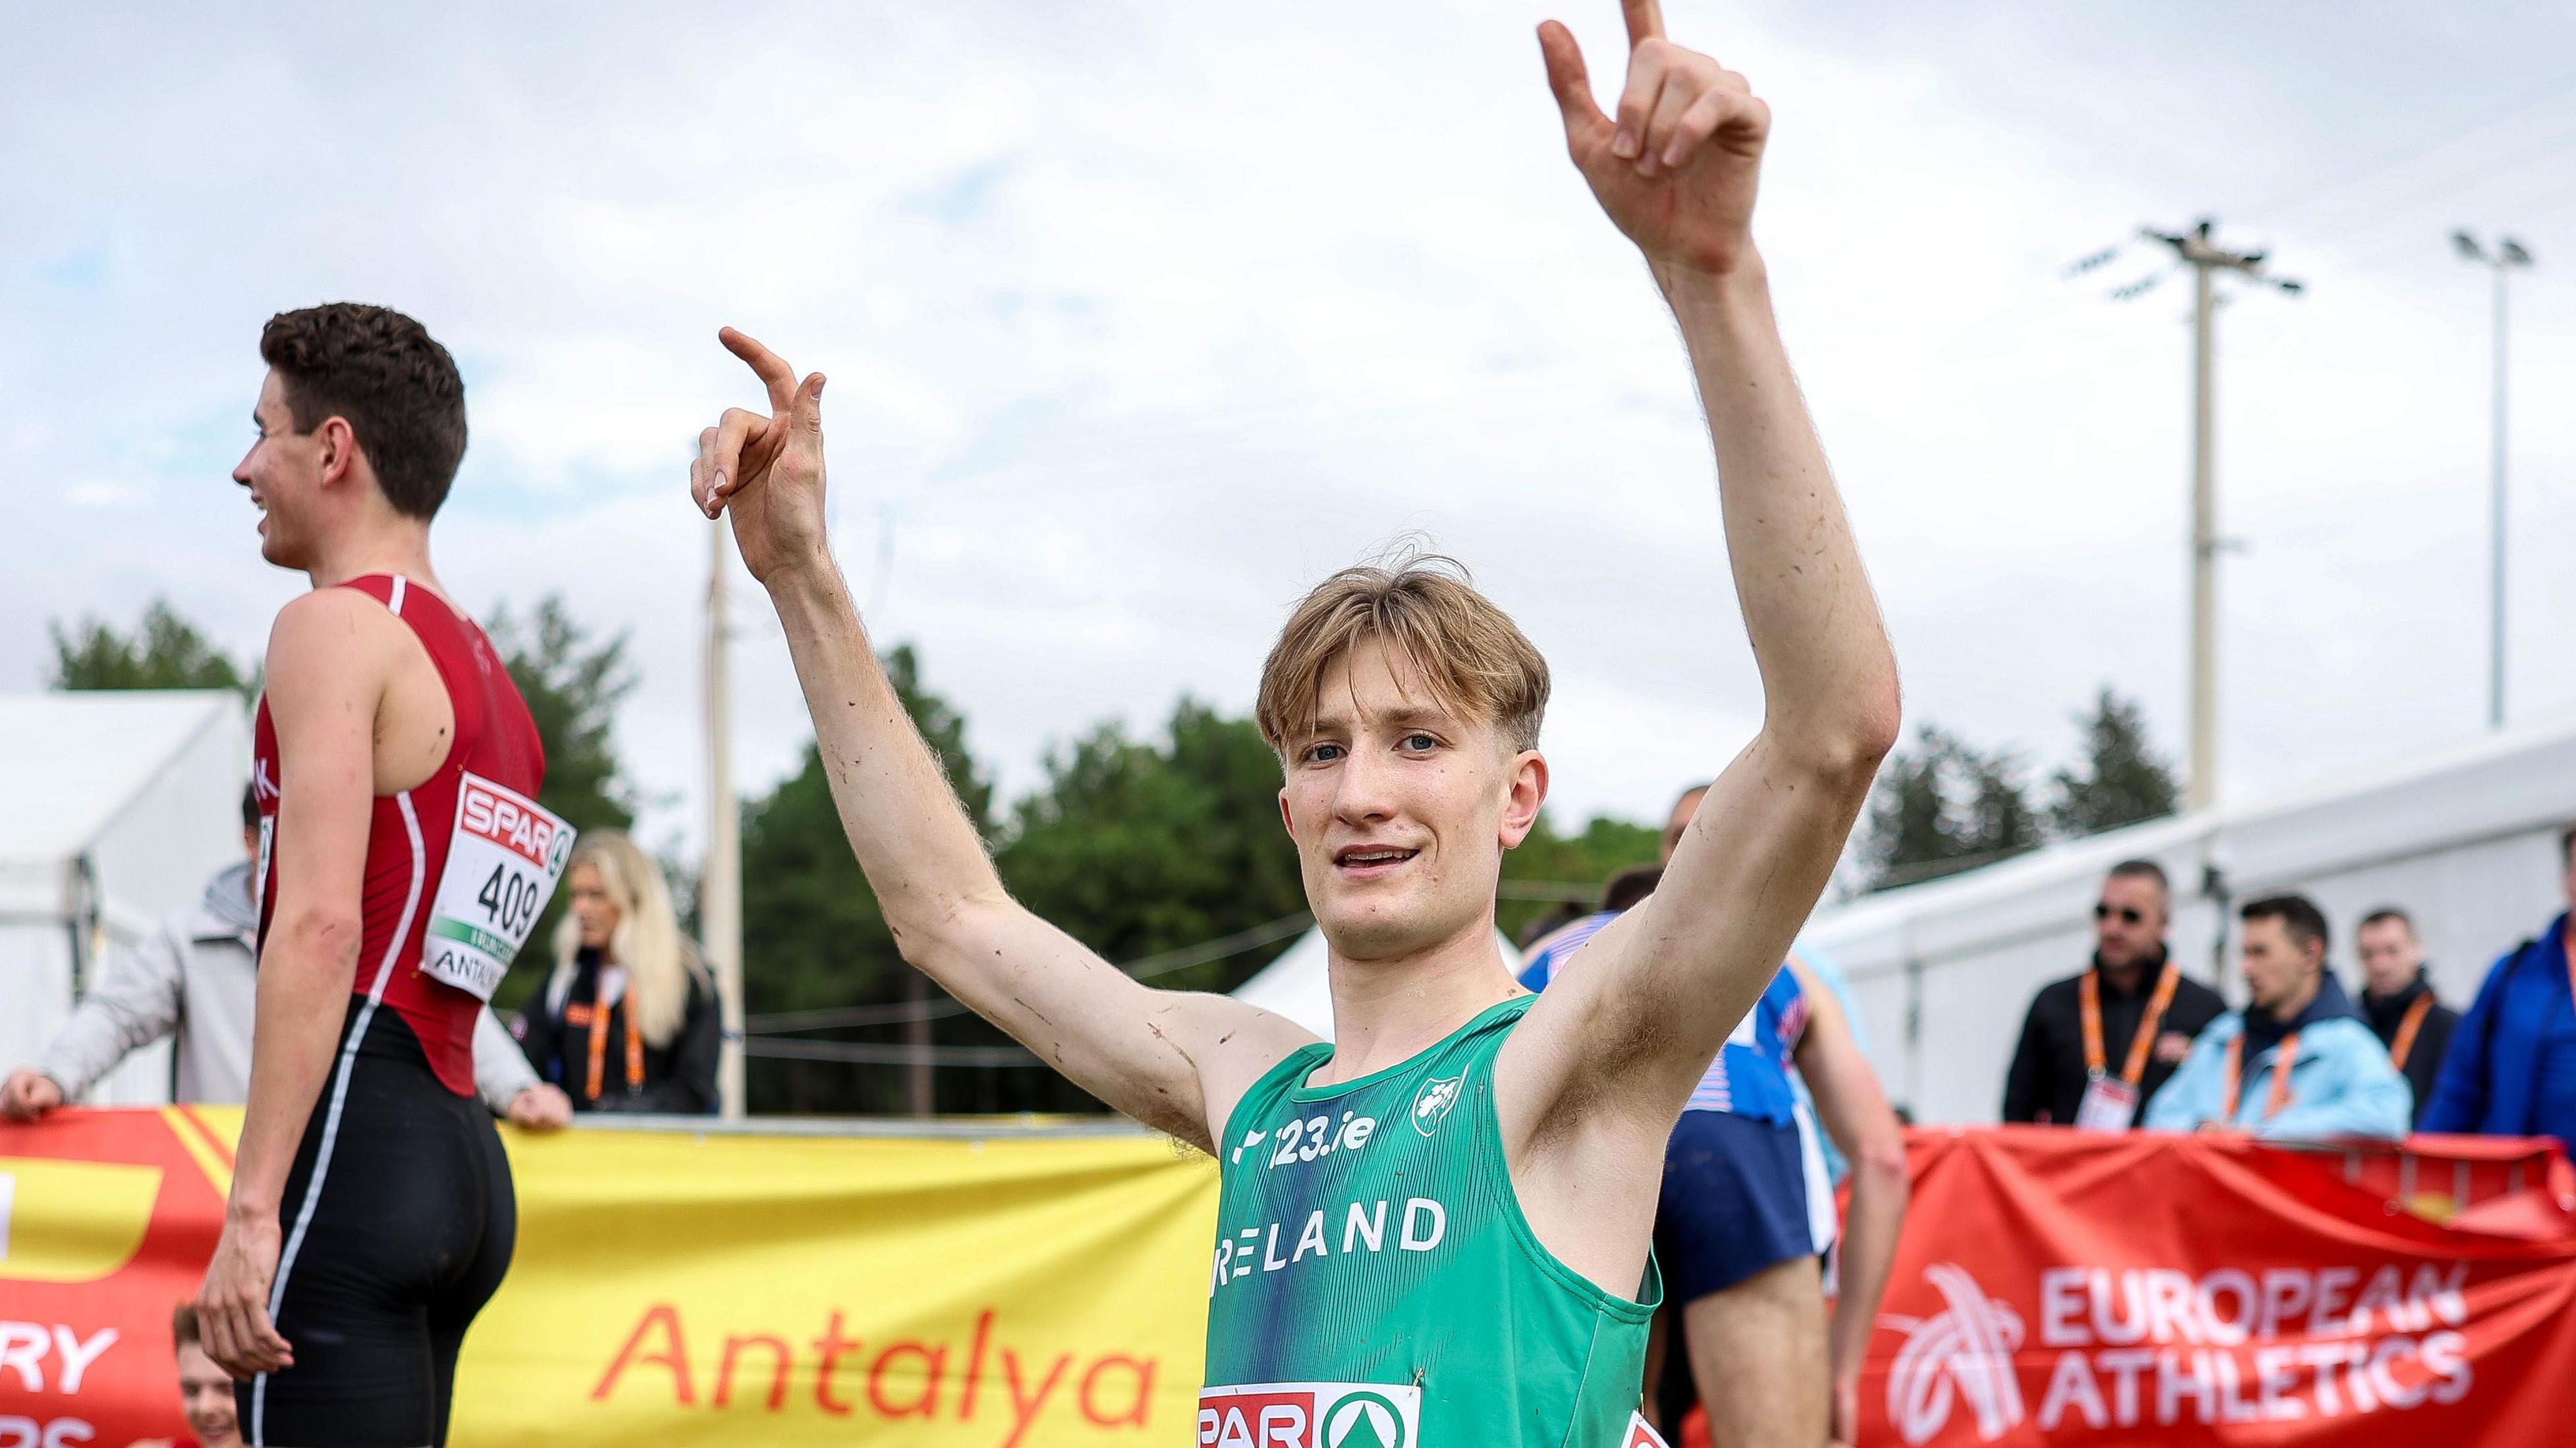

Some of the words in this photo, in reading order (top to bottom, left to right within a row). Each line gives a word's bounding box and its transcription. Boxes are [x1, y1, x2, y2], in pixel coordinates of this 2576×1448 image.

[464, 789, 551, 866] SPAR
[478, 861, 537, 938] 409
[1269, 1111, 1376, 1169] 123.ie
[2039, 1261, 2469, 1346] EUROPEAN
[0, 1320, 121, 1395] RY
[590, 1304, 1158, 1448] Antalya
[2037, 1331, 2474, 1431] ATHLETICS
[1197, 1406, 1307, 1448] PAR
